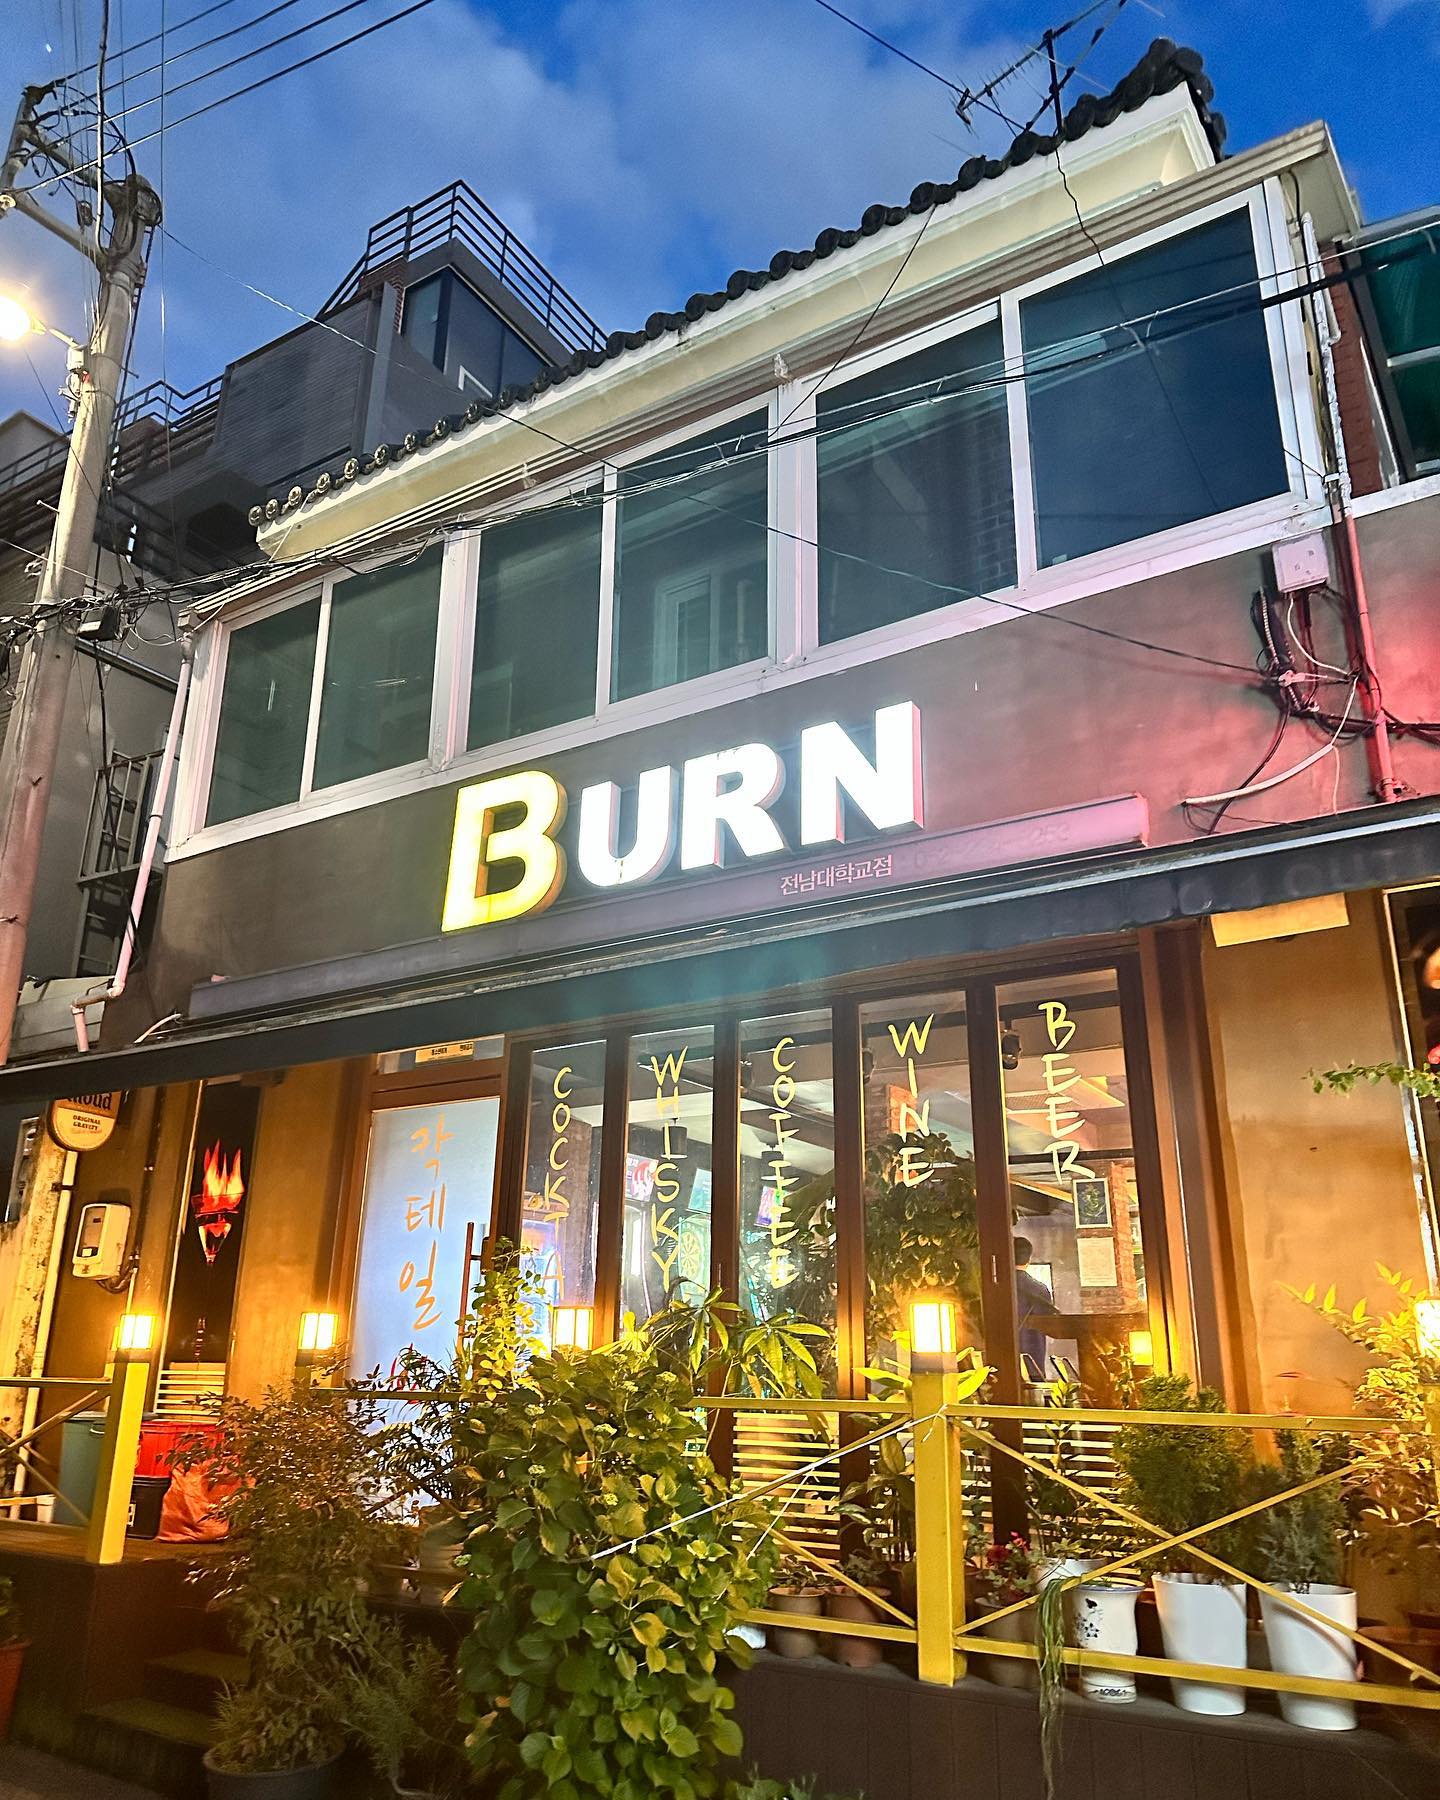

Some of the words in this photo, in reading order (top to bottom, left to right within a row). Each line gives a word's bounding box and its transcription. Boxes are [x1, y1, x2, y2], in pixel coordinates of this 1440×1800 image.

[441, 701, 924, 932] BURN
[779, 854, 894, 896] 전남대학교점
[72, 1114, 102, 1126] ORIGINAL
[72, 1121, 99, 1131] GRAVITY
[541, 1066, 572, 1300] COCKTA
[650, 1046, 688, 1293] WHISKY
[769, 1036, 799, 1289] COFFEE
[888, 1013, 936, 1188] WINE
[1038, 1001, 1095, 1185] BEER
[400, 1115, 453, 1331] 칵테일
